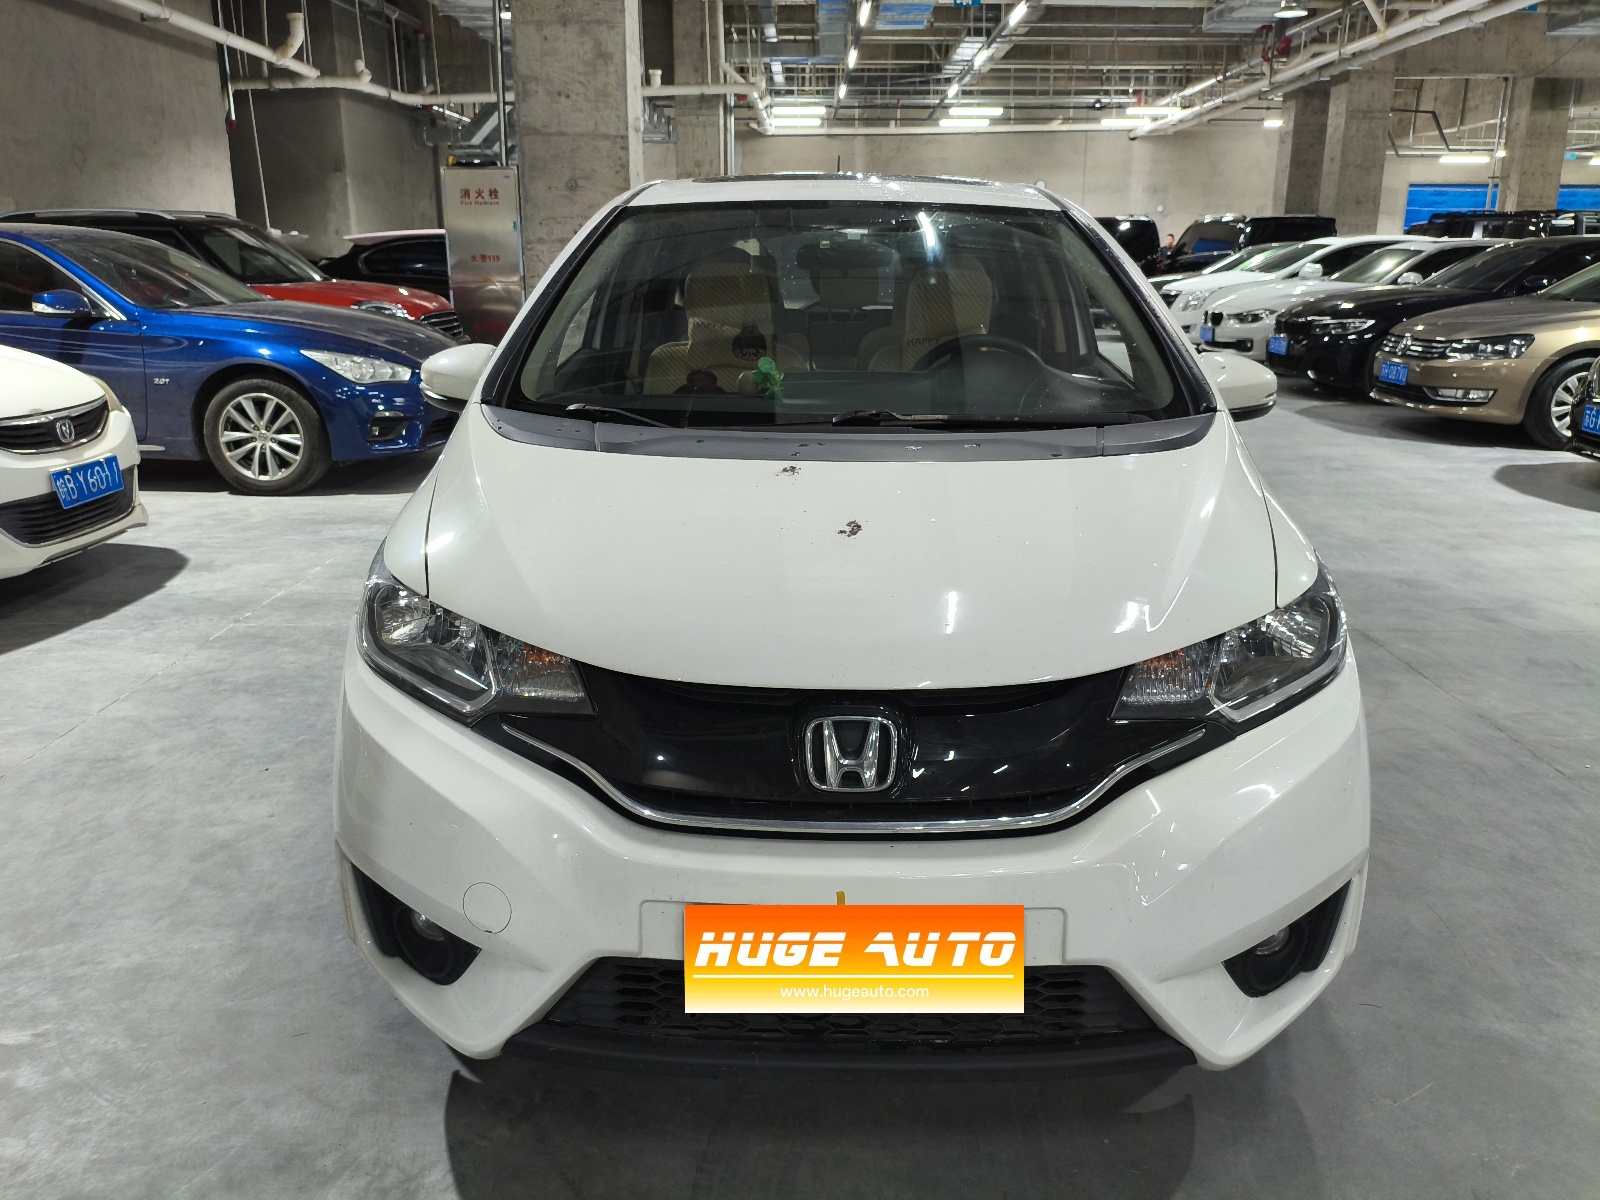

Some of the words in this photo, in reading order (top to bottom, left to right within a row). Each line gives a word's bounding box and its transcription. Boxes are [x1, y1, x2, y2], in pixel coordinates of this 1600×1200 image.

[460, 187, 499, 199] 消火栓
[470, 254, 500, 263] 火警119
